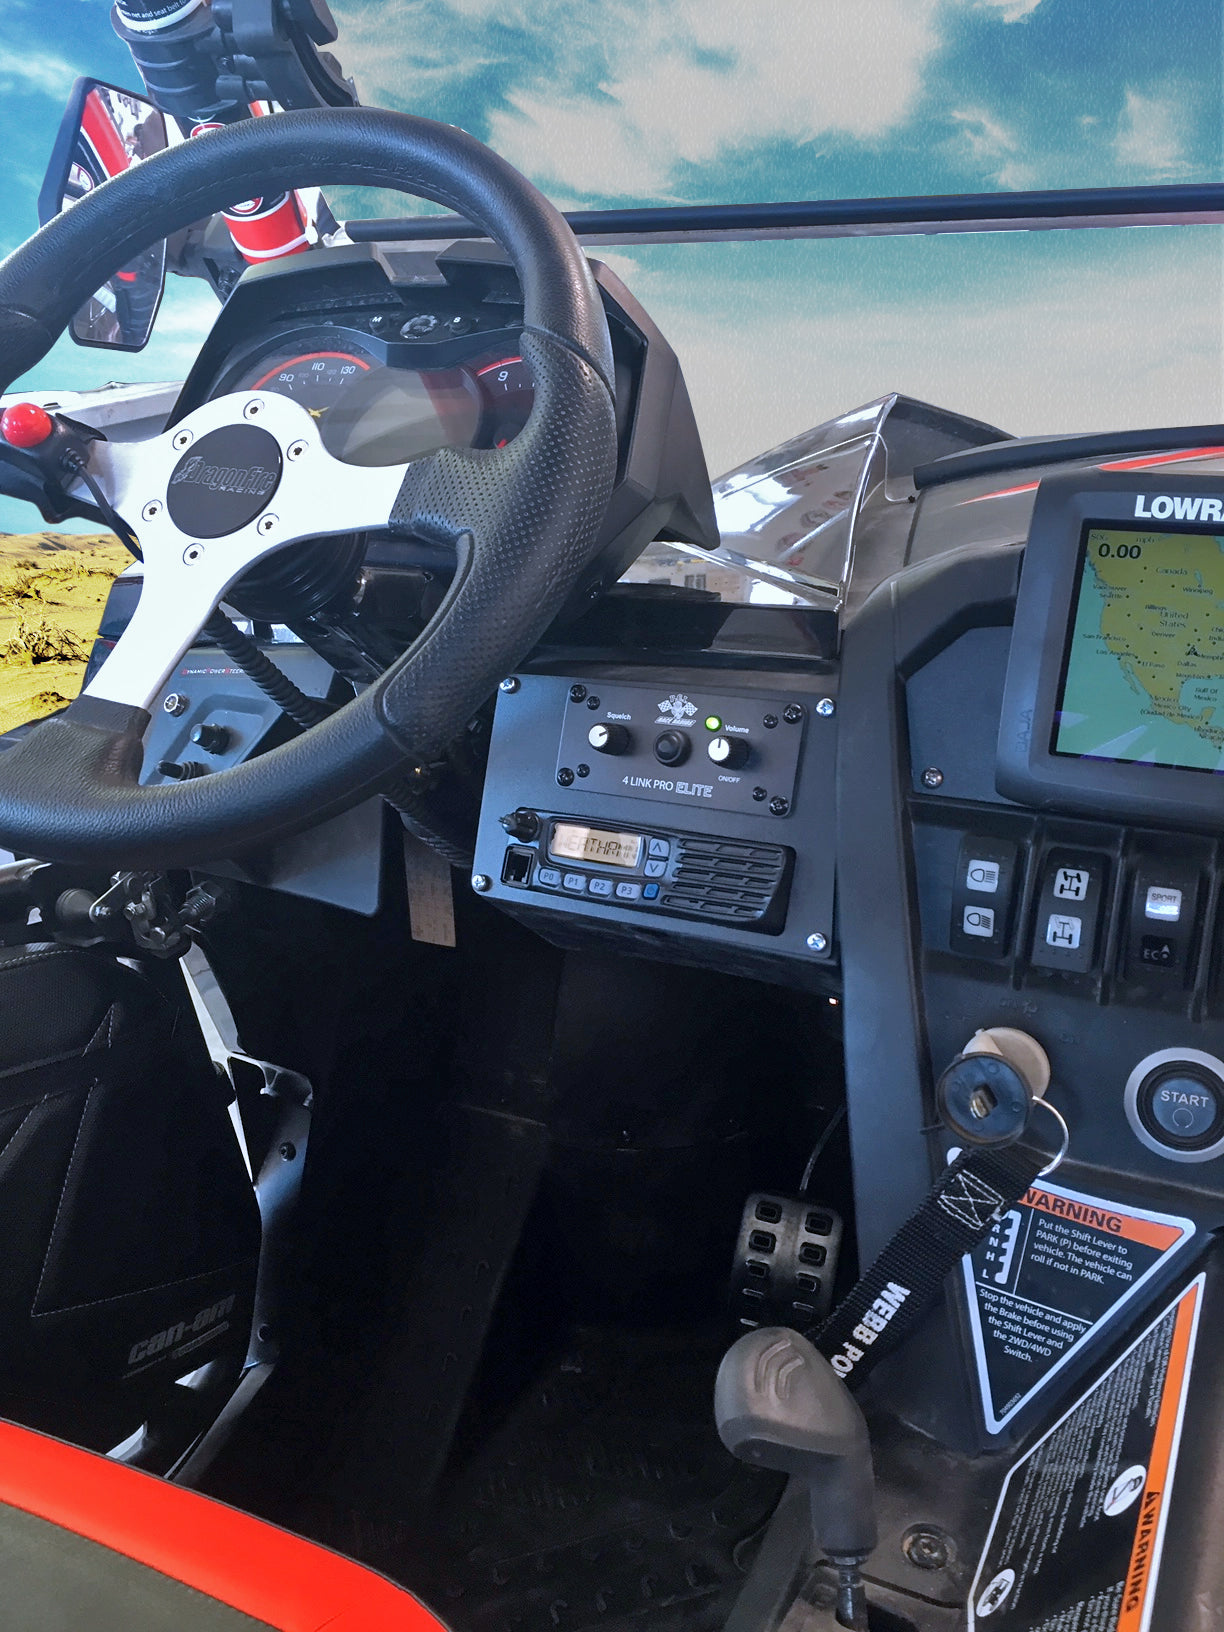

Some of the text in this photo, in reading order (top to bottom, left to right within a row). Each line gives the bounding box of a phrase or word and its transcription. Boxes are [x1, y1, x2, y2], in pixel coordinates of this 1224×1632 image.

[278, 373, 295, 382] 90
[312, 362, 326, 371] 110
[340, 366, 356, 375] 130
[497, 370, 509, 382] 9
[1134, 494, 1224, 522] LOWR
[1098, 543, 1142, 559] 0.00
[606, 711, 631, 720] Squelch
[725, 724, 750, 733] Volume
[622, 776, 713, 798] 4 LINK PRO ELITE
[568, 876, 578, 885] P1
[593, 881, 605, 891] P2
[621, 885, 632, 895] P3
[1151, 892, 1177, 904] SPORT
[1160, 1090, 1209, 1108] START
[991, 1223, 1000, 1234] R
[1038, 1218, 1128, 1255] Put the Shift Lever to
[988, 1236, 999, 1247] N
[1036, 1229, 1133, 1271] PARK (P) before exiting
[985, 1250, 995, 1262] H
[1033, 1242, 1133, 1281] vehicle. The vehicle can
[981, 1268, 989, 1279] L
[1030, 1253, 1105, 1285] roll if not in PARK.
[852, 1281, 911, 1345] WEBB
[979, 1288, 1087, 1335] Stop the vehicle and apply
[127, 1294, 237, 1365] can-am
[984, 1302, 1075, 1343] the Brake before using
[988, 1316, 1064, 1350] the Shift Lever and
[993, 1329, 1052, 1357] the 2WD/4WD
[1003, 1345, 1033, 1363] Switch.
[1126, 1506, 1156, 1613] WARNING
